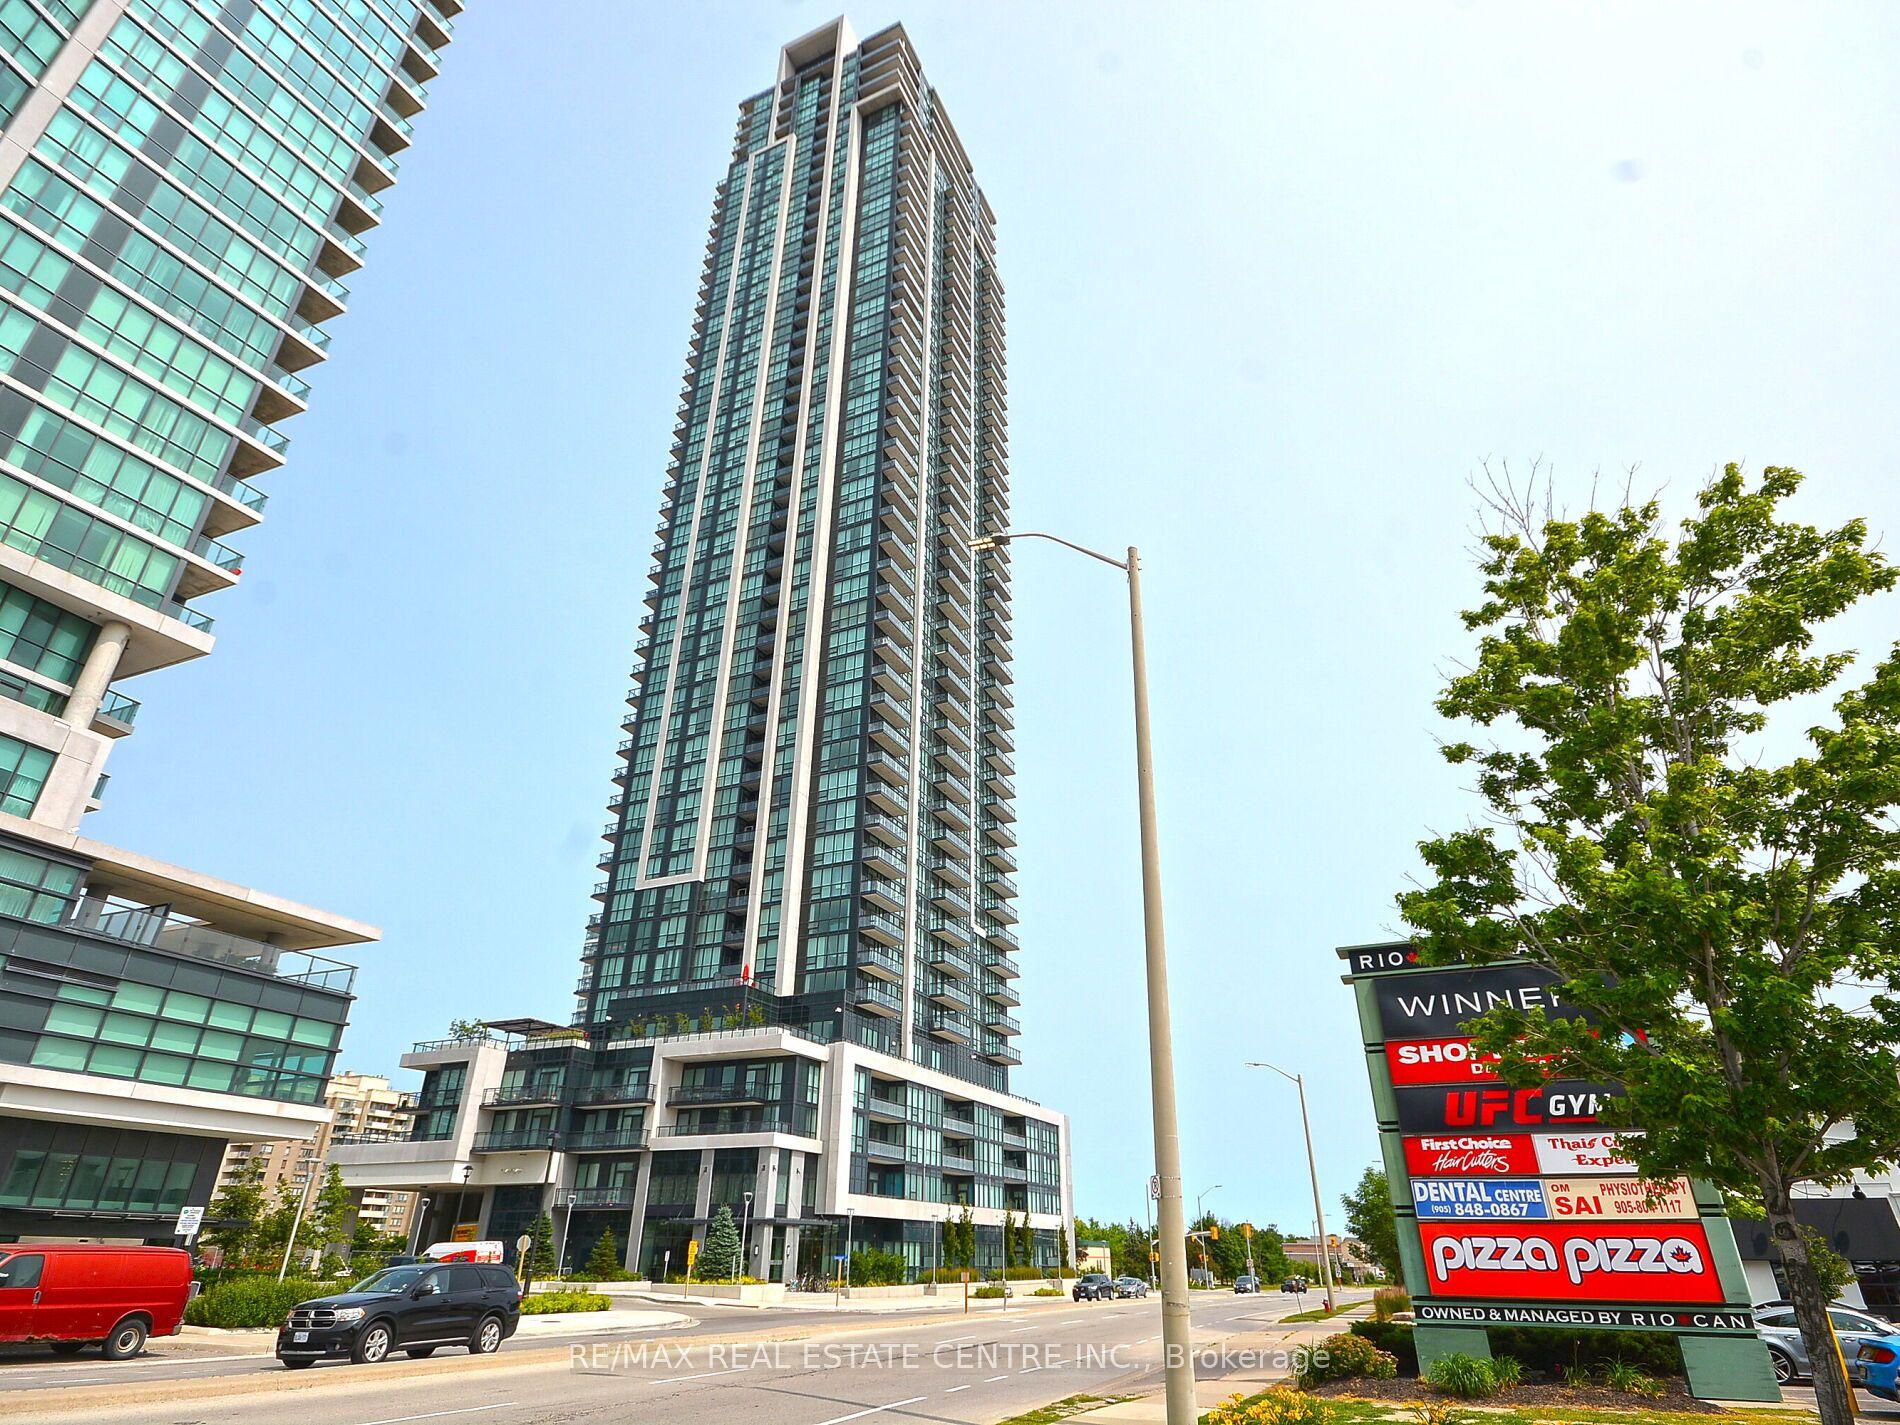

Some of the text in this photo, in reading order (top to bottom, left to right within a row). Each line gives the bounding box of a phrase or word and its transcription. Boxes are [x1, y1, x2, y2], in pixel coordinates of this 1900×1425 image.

[1359, 951, 1404, 970] RIO
[1444, 1088, 1543, 1127] UFC
[1413, 1181, 1542, 1203] DENTAL CENTRE
[1550, 1184, 1570, 1193] OM
[1431, 1203, 1528, 1216] (905) 848-0867
[1555, 1195, 1603, 1215] SAI
[1421, 1306, 1746, 1329] OWNED & MANAGED BY RIO CAN
